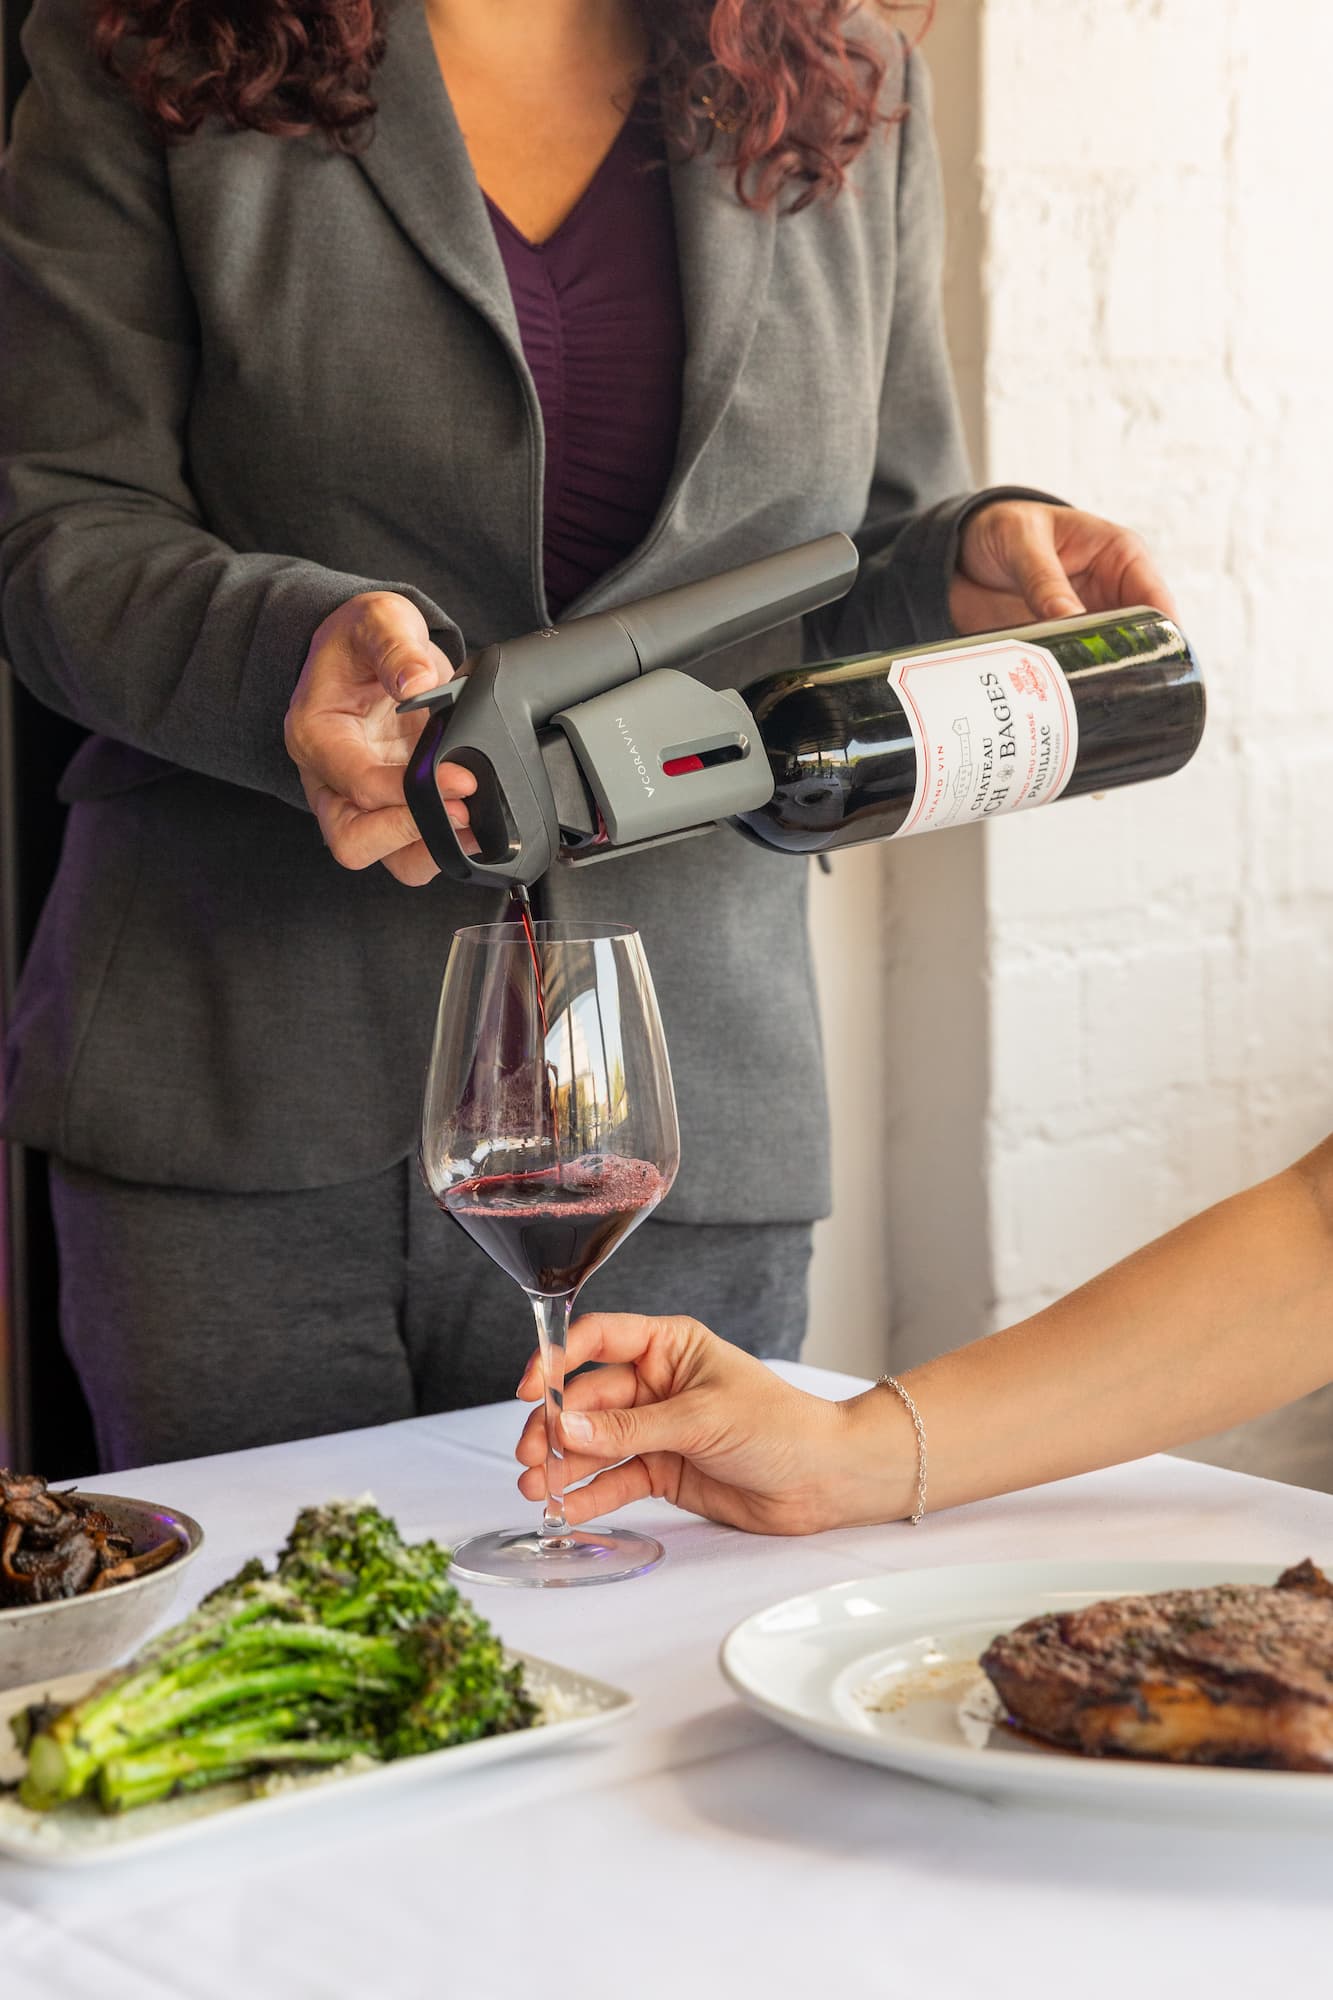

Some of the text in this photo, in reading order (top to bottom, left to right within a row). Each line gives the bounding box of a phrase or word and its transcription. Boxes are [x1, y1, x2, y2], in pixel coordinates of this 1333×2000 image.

[979, 673, 1016, 759] BAGES
[924, 745, 945, 820] GRAND VIN
[970, 737, 993, 811] CHATEAU
[1026, 759, 1036, 781] CRU
[1027, 724, 1051, 799] PAUILLAC
